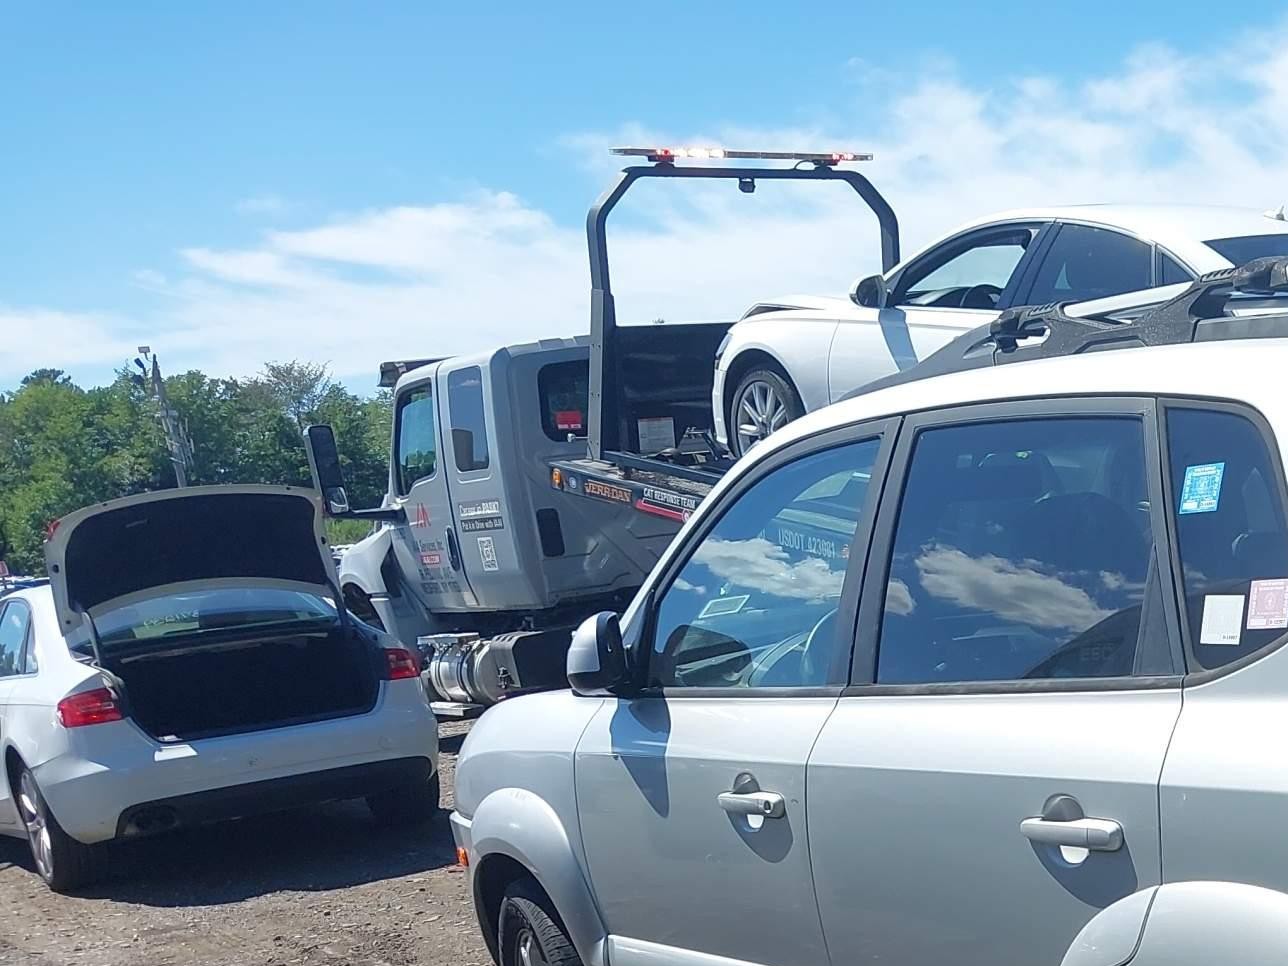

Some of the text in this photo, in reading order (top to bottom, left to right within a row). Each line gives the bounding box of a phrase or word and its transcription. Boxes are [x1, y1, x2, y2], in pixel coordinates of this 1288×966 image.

[643, 487, 696, 509] CAT RESPONSE TEAM
[778, 528, 804, 551] USDOT
